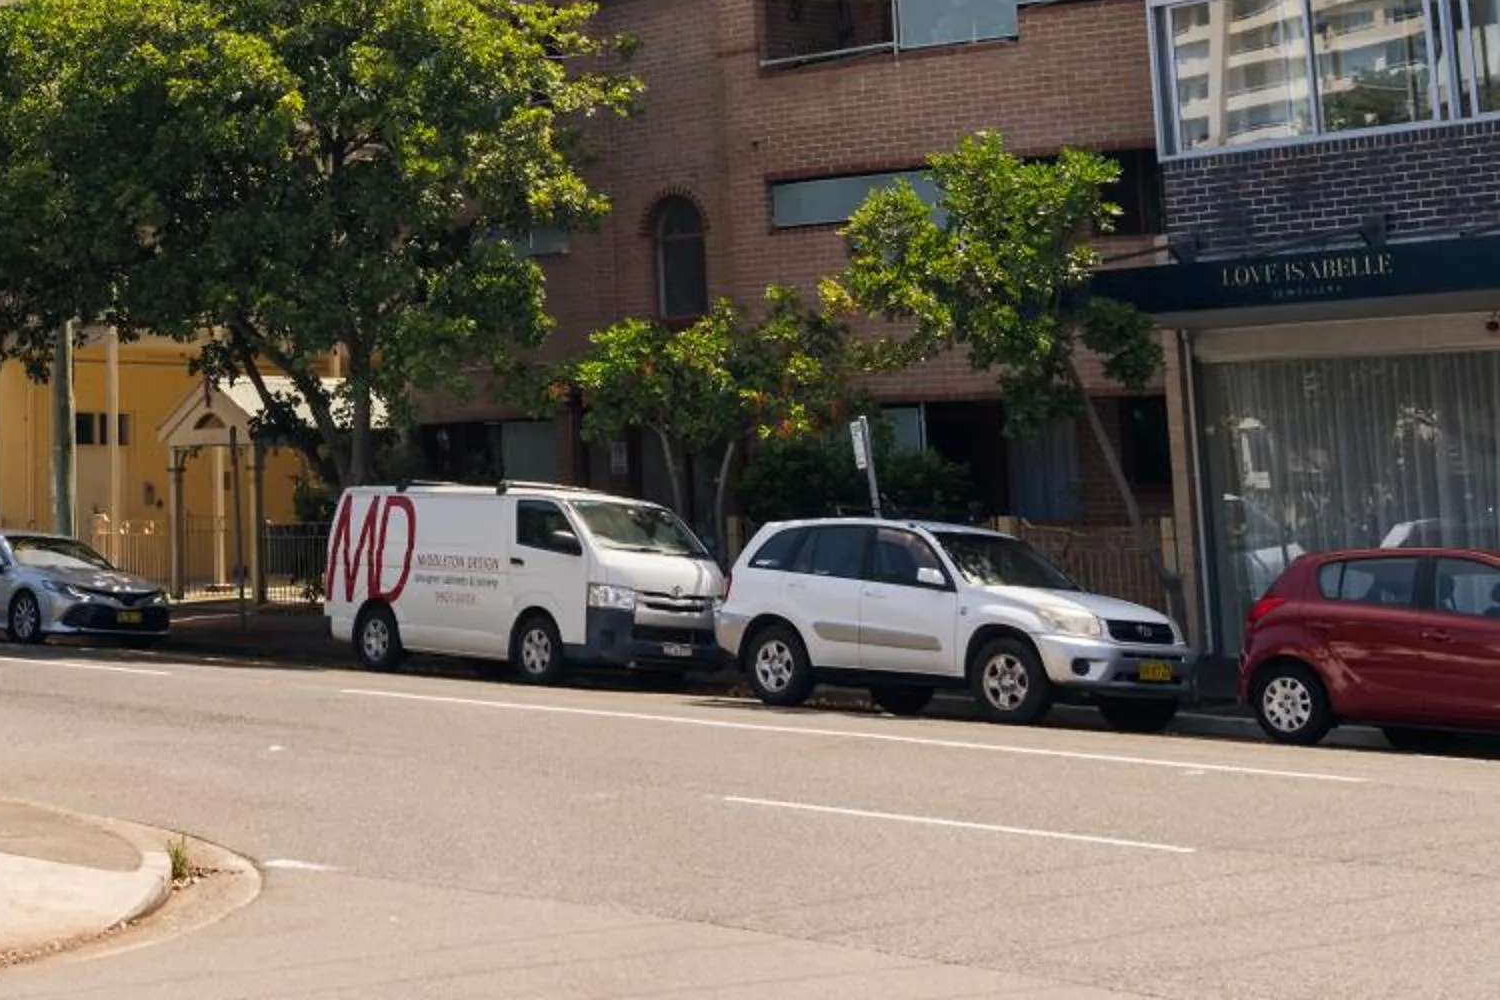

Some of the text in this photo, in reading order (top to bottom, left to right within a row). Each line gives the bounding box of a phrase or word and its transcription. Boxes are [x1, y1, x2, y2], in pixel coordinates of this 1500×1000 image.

[1222, 253, 1393, 287] LOVE ISABELLE
[326, 494, 416, 602] MD
